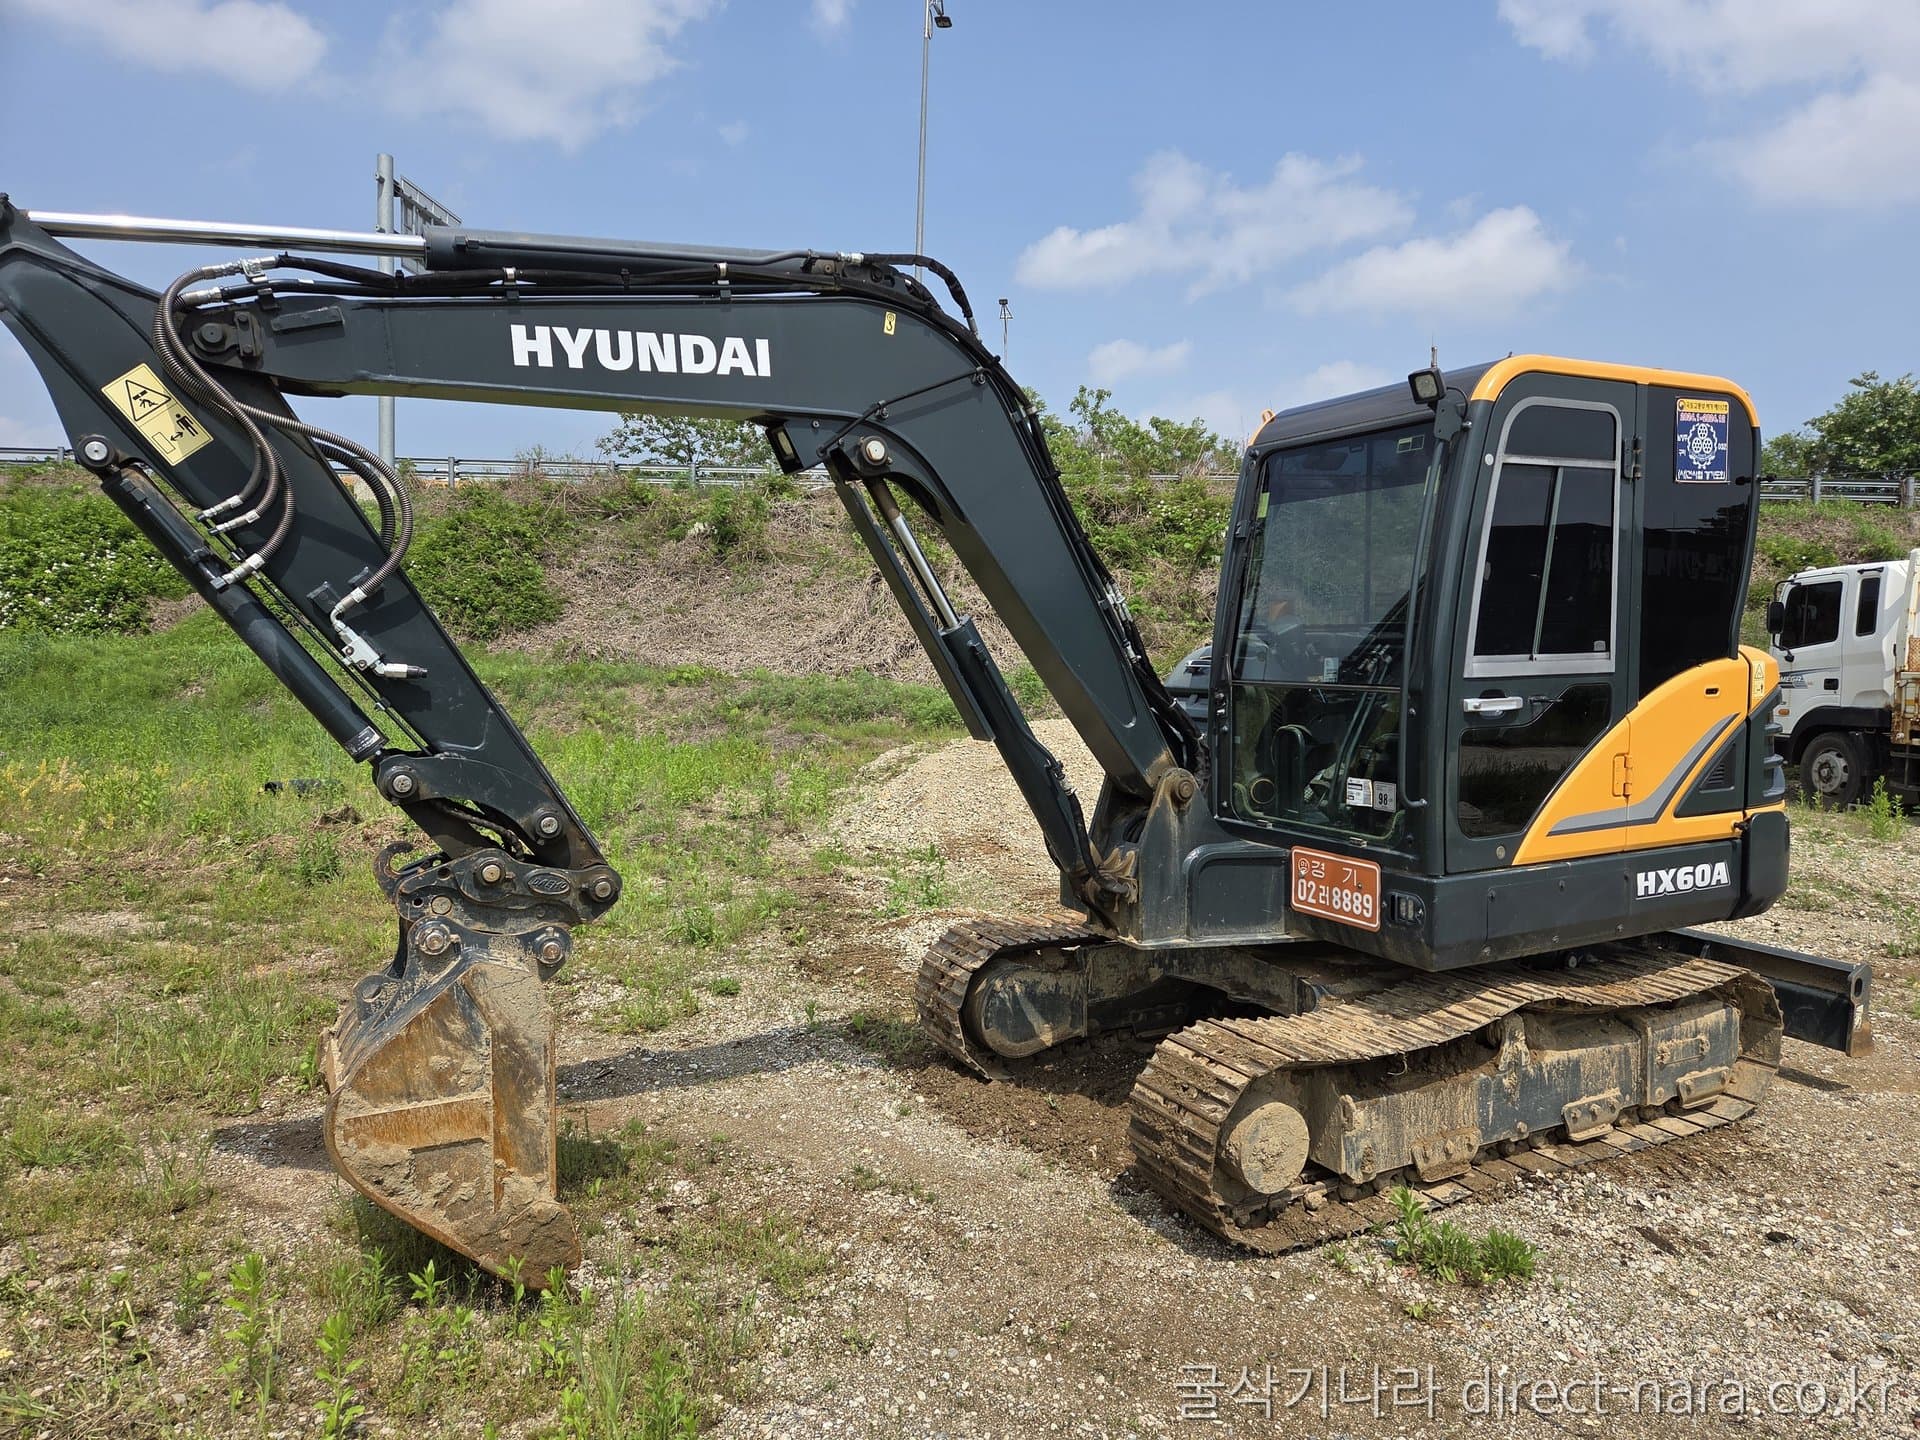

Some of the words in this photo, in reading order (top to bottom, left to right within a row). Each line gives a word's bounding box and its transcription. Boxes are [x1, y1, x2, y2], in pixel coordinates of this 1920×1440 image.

[510, 323, 771, 377] HYUNDAI
[1378, 792, 1388, 805] 98
[1297, 878, 1373, 918] 02러8889
[1636, 861, 1730, 897] HX60A
